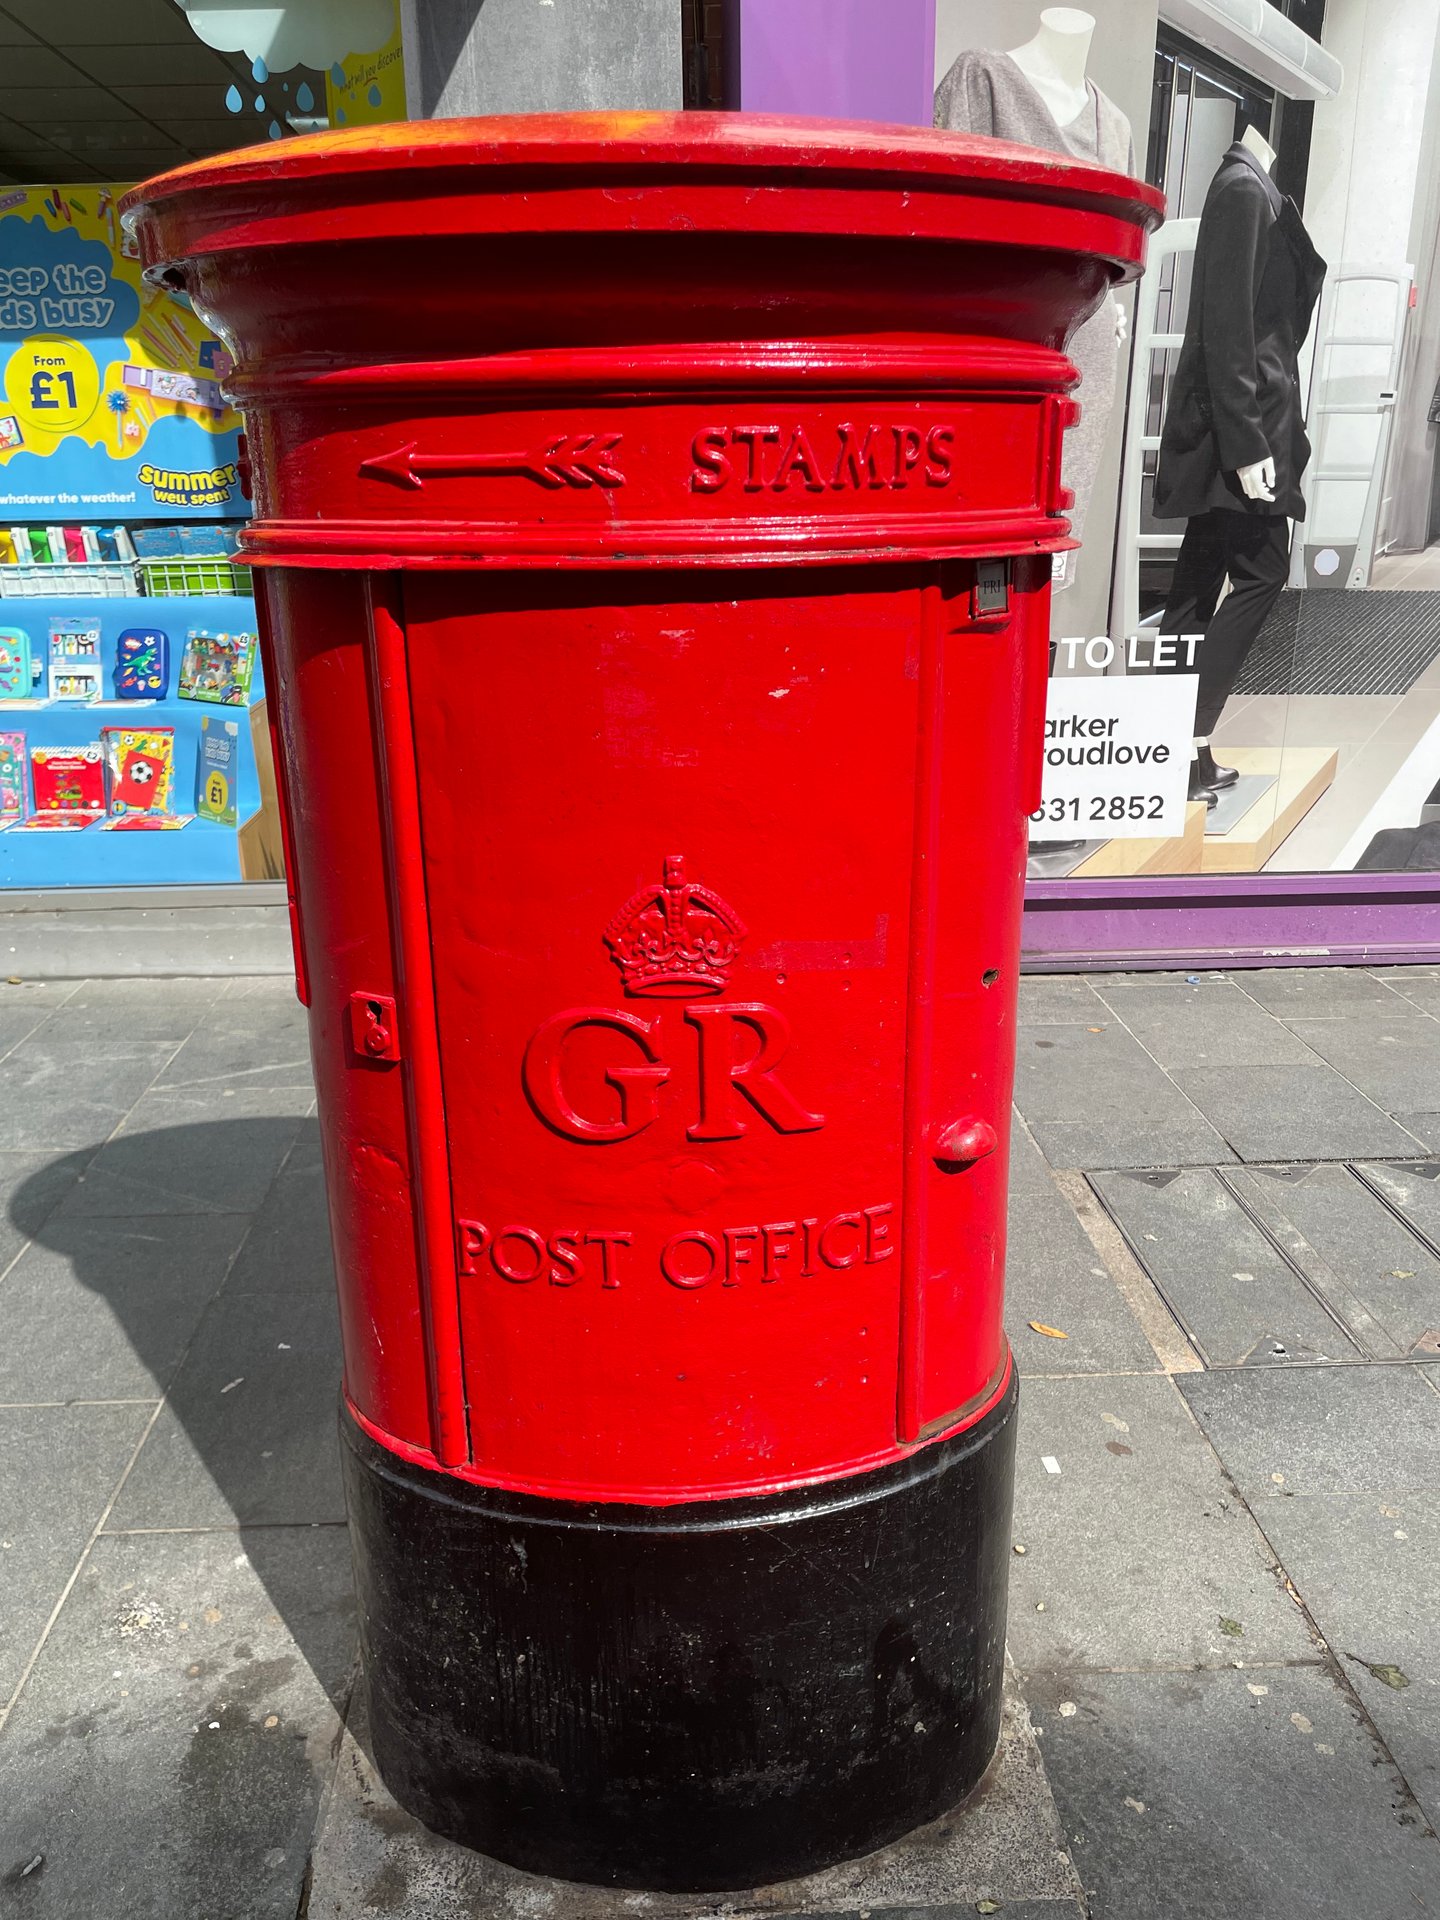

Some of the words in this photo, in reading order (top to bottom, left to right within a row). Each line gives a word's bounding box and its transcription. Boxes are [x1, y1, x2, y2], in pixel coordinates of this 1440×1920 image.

[53, 264, 106, 294] the
[41, 298, 115, 327] busy
[33, 355, 66, 366] From
[30, 371, 77, 409] £1
[691, 423, 955, 493] STAMPS
[138, 463, 237, 492] summer
[0, 493, 56, 504] whatever
[57, 492, 81, 504] the
[87, 491, 136, 503] weather!
[153, 489, 187, 505] well
[190, 487, 230, 506] spent
[982, 579, 1002, 595] FRI
[1061, 636, 1115, 669] TO
[1128, 634, 1205, 667] LET
[1044, 715, 1119, 739] arker
[1044, 741, 1170, 766] oudlove
[1089, 795, 1164, 820] 2852
[521, 1002, 826, 1145] GR
[457, 1218, 632, 1289] POST
[660, 1202, 895, 1289] OFFICE
